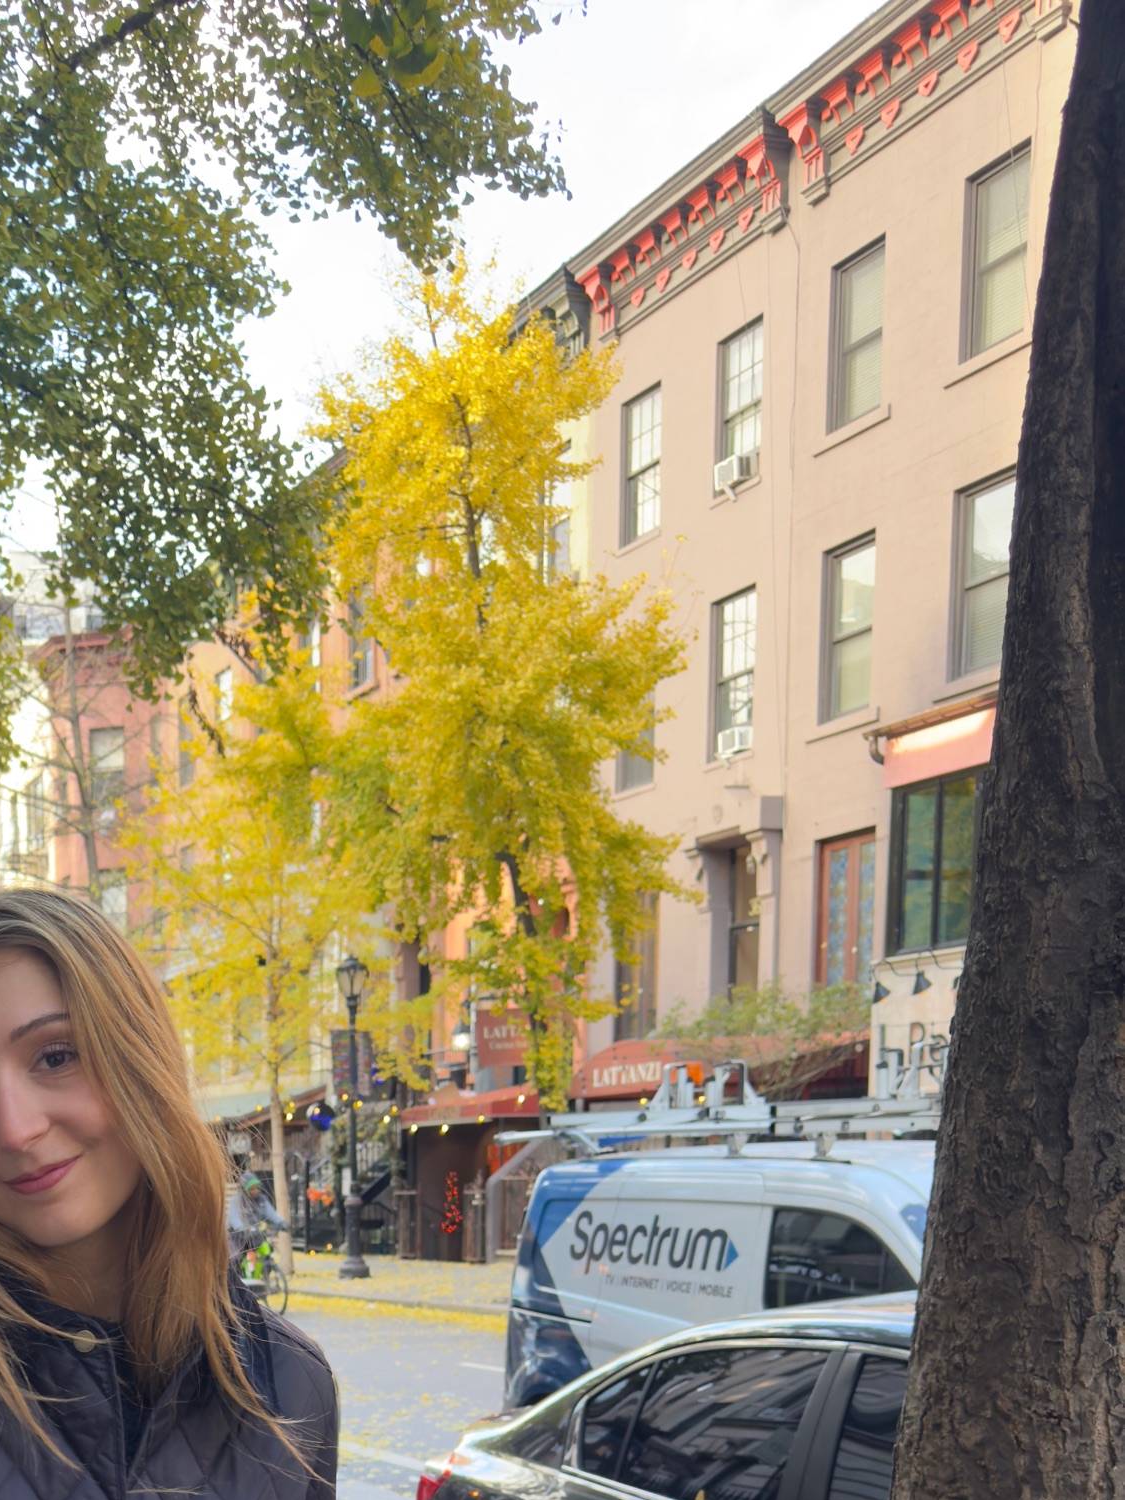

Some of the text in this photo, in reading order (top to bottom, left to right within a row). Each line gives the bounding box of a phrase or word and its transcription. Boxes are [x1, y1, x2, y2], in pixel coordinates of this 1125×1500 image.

[592, 1061, 663, 1088] LATTANZI
[570, 1210, 729, 1275] Spectrum
[605, 1274, 734, 1298] TV INTERNET VOICE MOBILE
